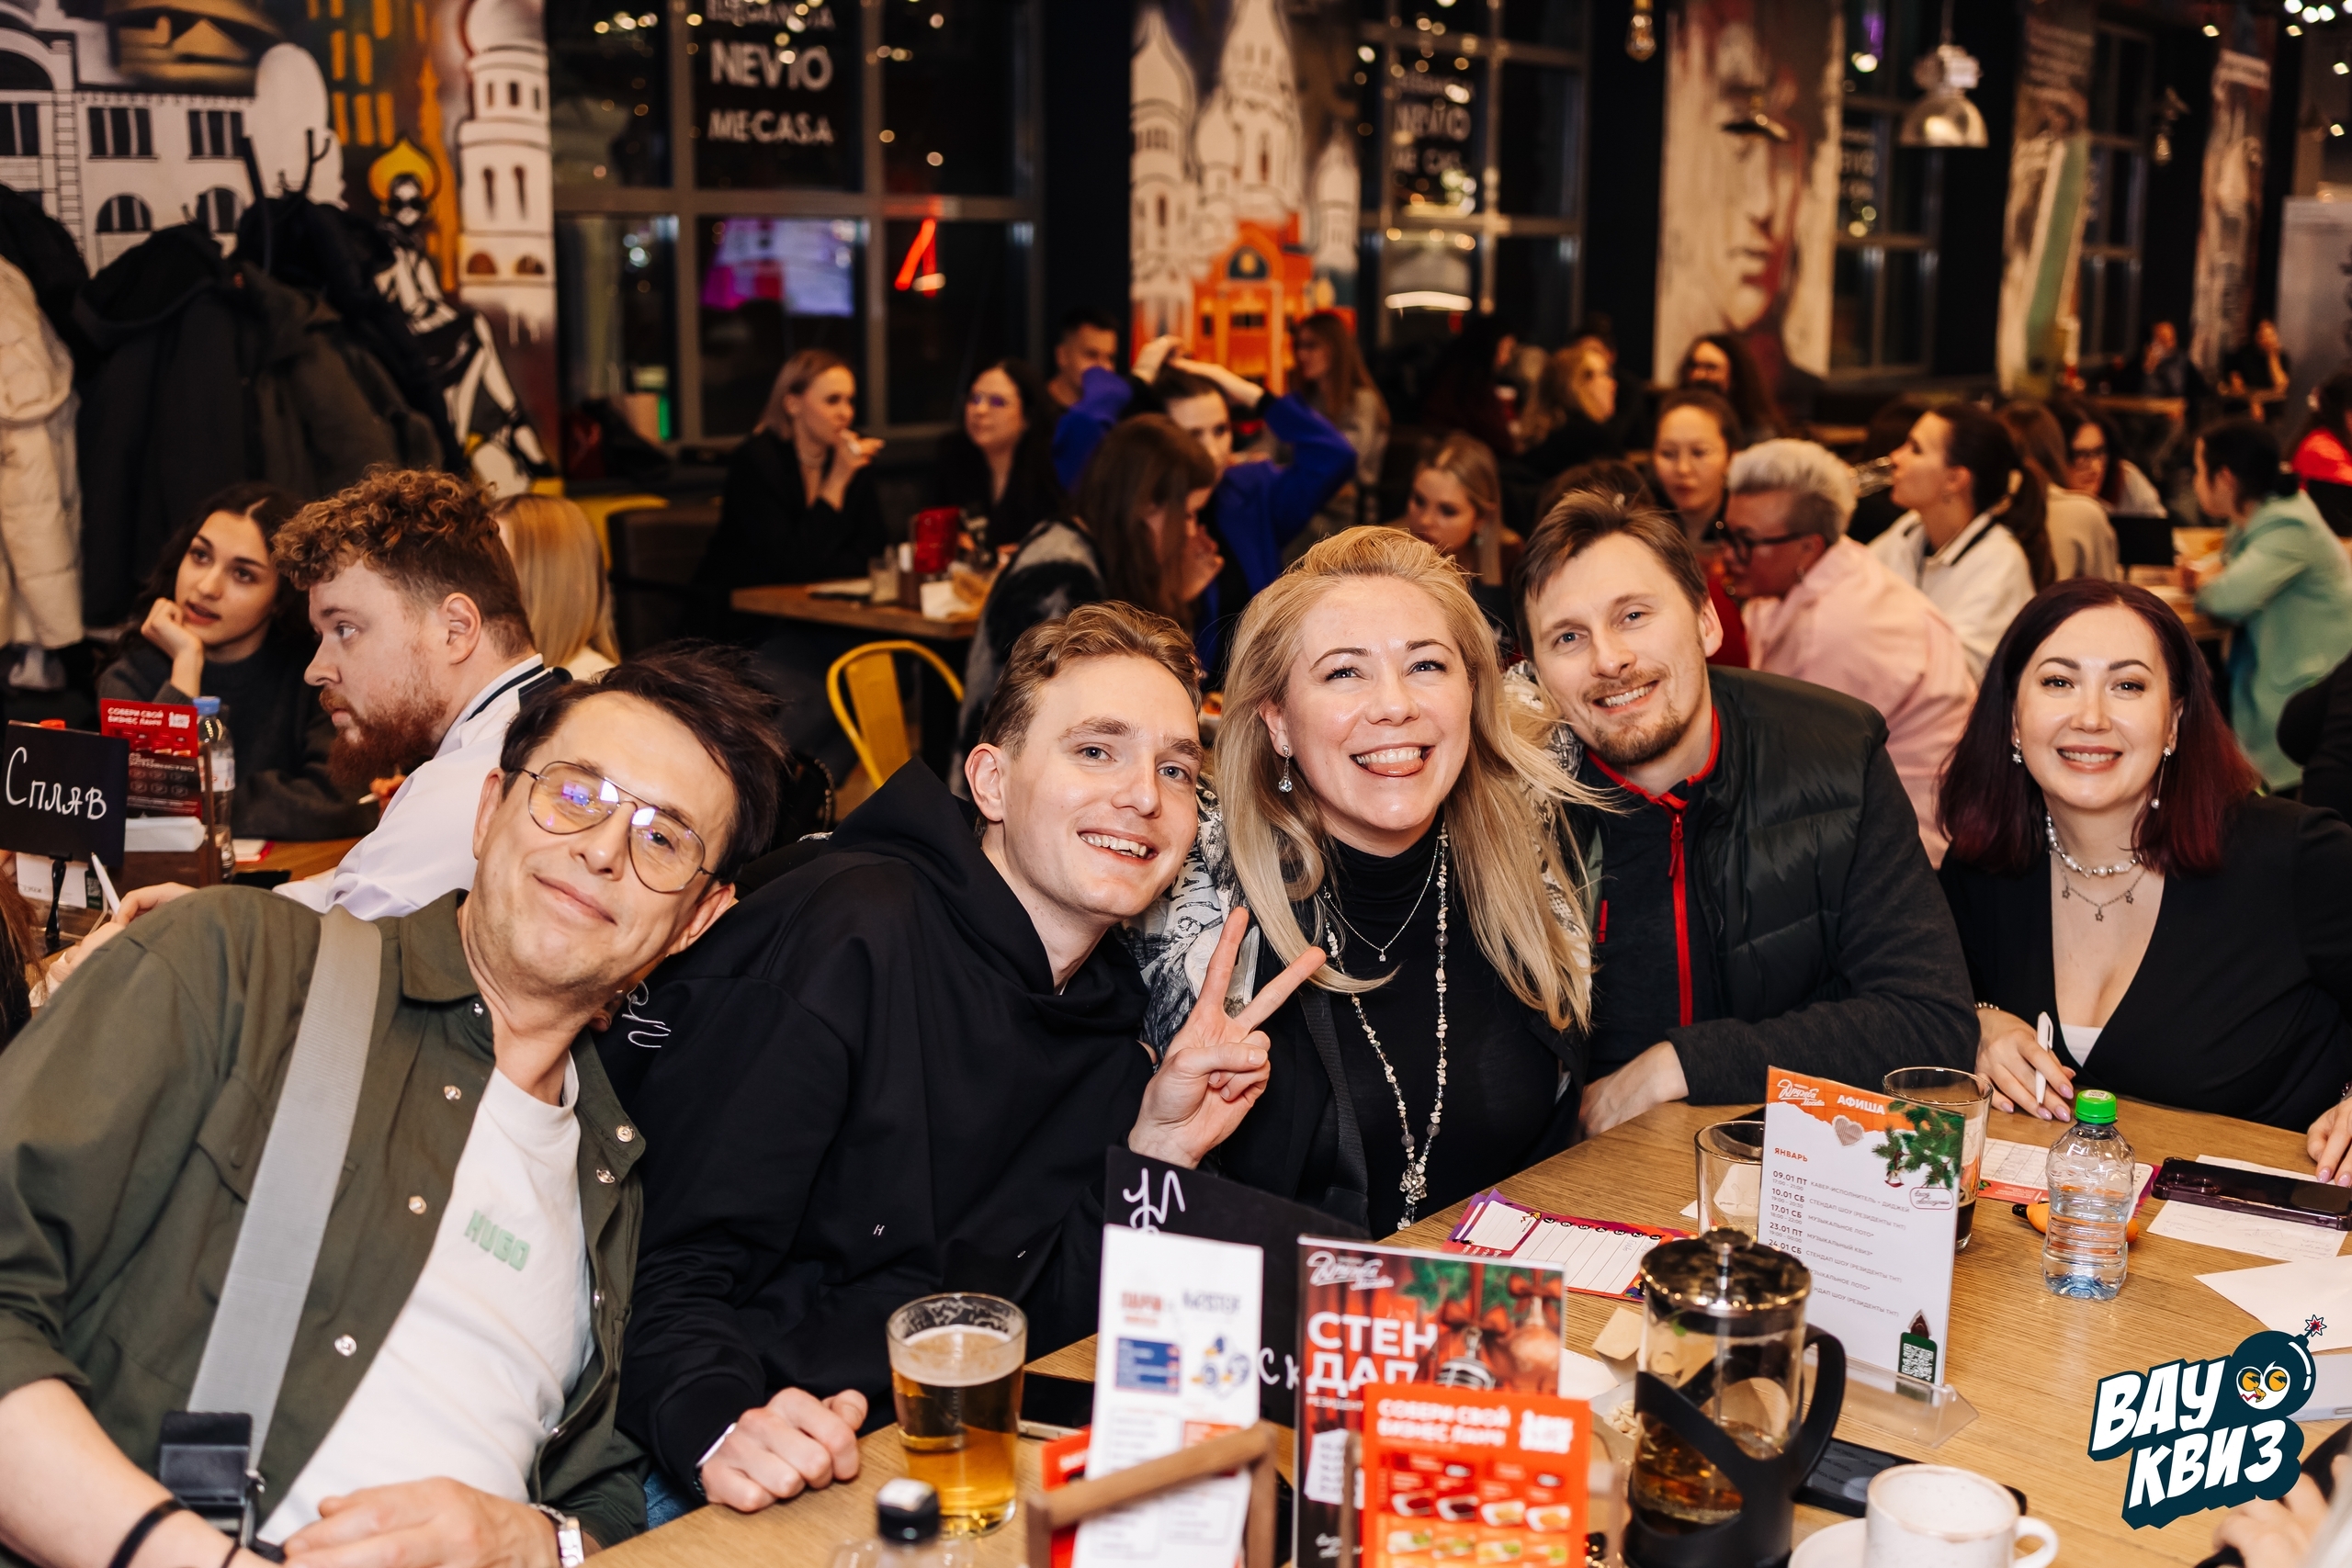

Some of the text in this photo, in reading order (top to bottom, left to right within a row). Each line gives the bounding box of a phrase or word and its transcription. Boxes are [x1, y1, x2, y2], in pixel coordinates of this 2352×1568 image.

[1837, 1094, 1885, 1115] АФИША
[1774, 1147, 1808, 1162] ЯНВАРЬ
[1772, 1170, 1794, 1182] 09.01
[1771, 1188, 1804, 1202] 10.01 СБ
[1771, 1204, 1802, 1219] 17.01 СБ
[1809, 1198, 1837, 1210] СТЕНДАП
[1838, 1206, 1853, 1214] ШОУ
[1770, 1222, 1803, 1237] 23.01 ПТ
[464, 1210, 531, 1271] HUGO
[1769, 1239, 1802, 1254] 24.01 СБ
[1805, 1249, 1834, 1262] СТЕНДАП
[1835, 1258, 1849, 1267] ШОУ
[1809, 1269, 1849, 1285] УЗЫКАЛЬНОЕ
[1831, 1292, 1846, 1301] ШОУ
[1307, 1312, 1438, 1358] СТЕН
[1306, 1351, 1419, 1397] ДАП
